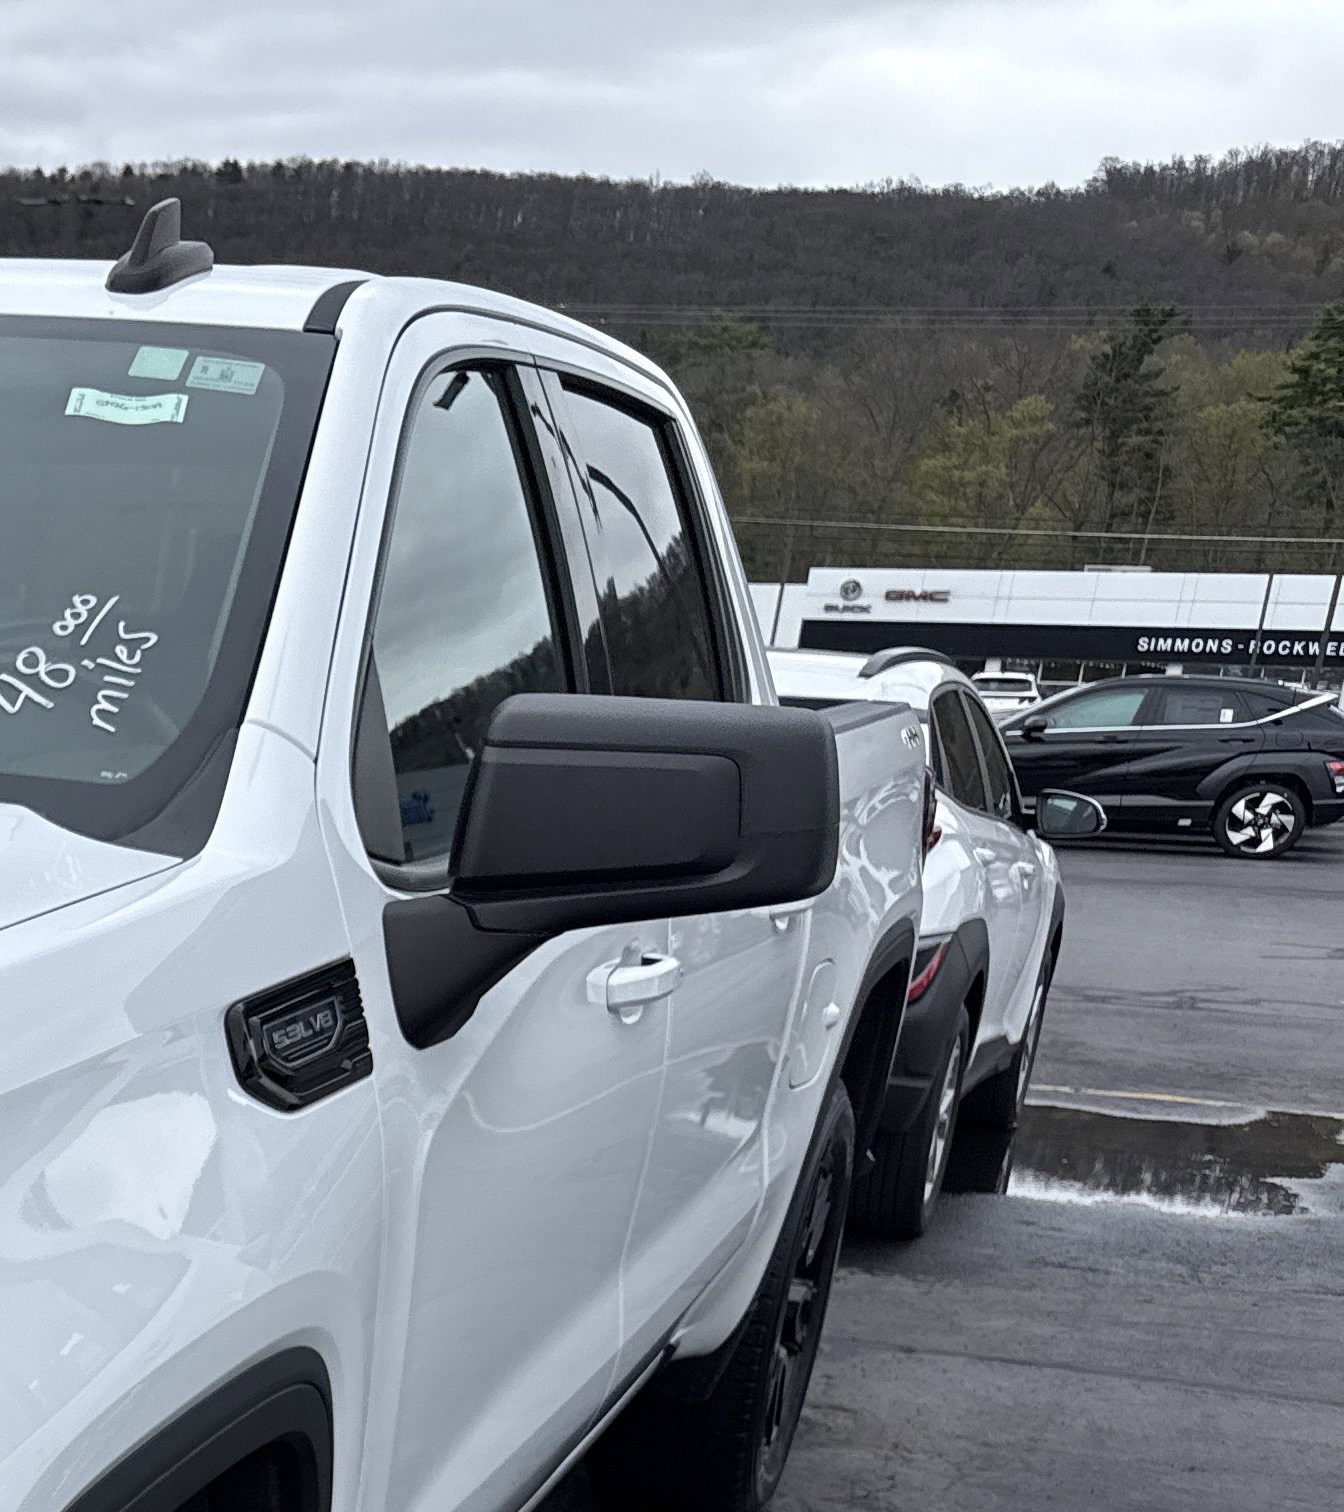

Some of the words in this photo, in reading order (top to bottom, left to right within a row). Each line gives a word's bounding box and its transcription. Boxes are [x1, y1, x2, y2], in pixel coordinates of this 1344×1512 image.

[885, 589, 950, 603] GMC
[1137, 637, 1233, 654] SIMMONS
[81, 619, 158, 732] miles
